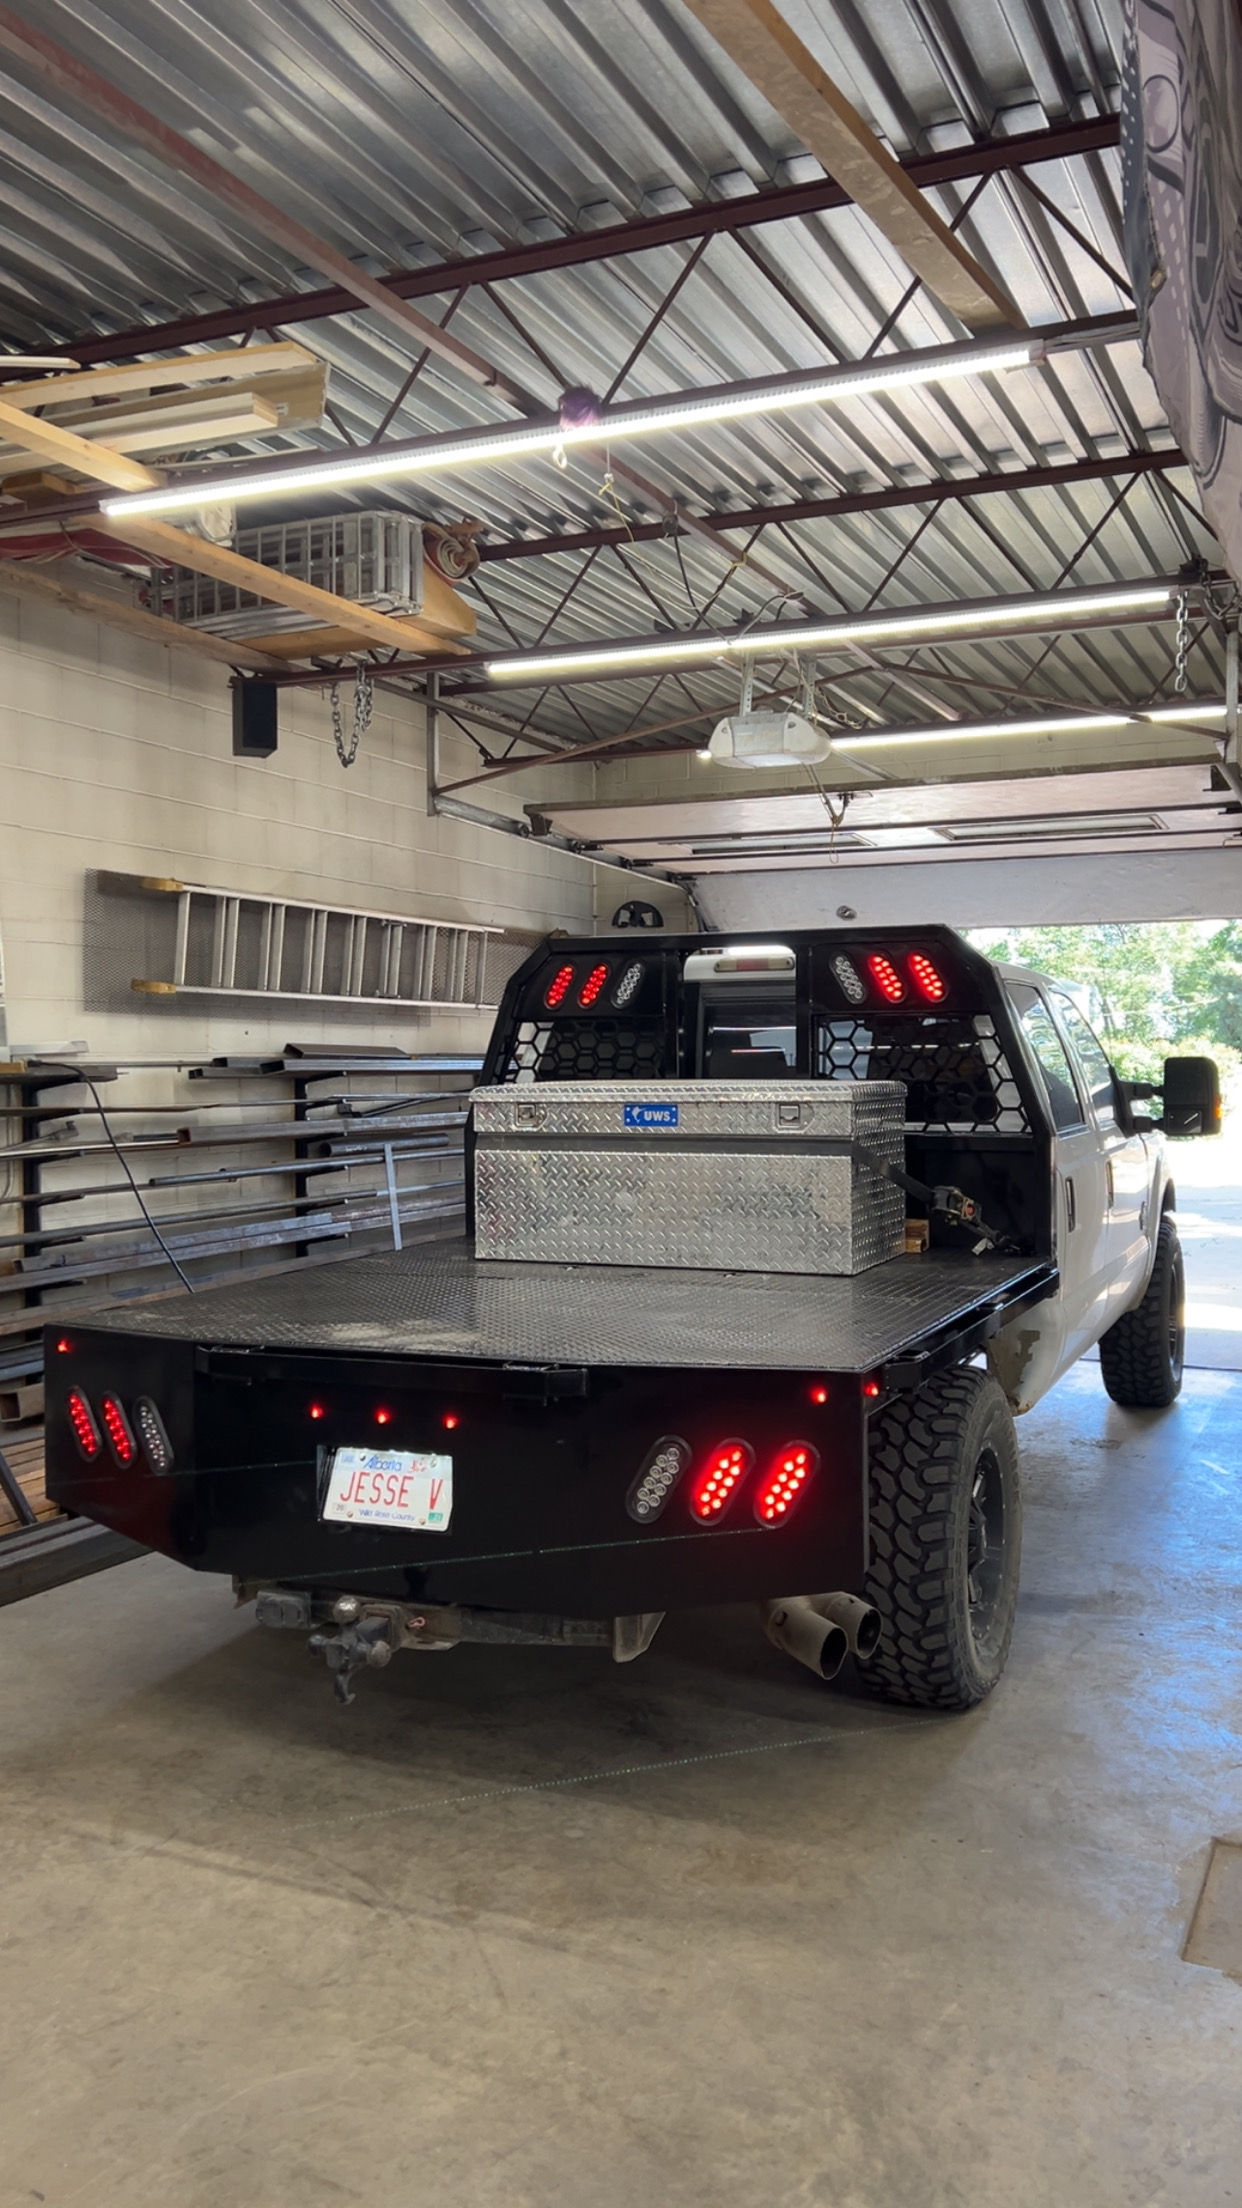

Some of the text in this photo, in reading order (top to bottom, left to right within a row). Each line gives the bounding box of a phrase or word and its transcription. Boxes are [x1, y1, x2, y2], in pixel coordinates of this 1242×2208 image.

[644, 1111, 671, 1122] UWS
[364, 1454, 402, 1471] Alberta
[340, 1472, 444, 1510] JESSE V
